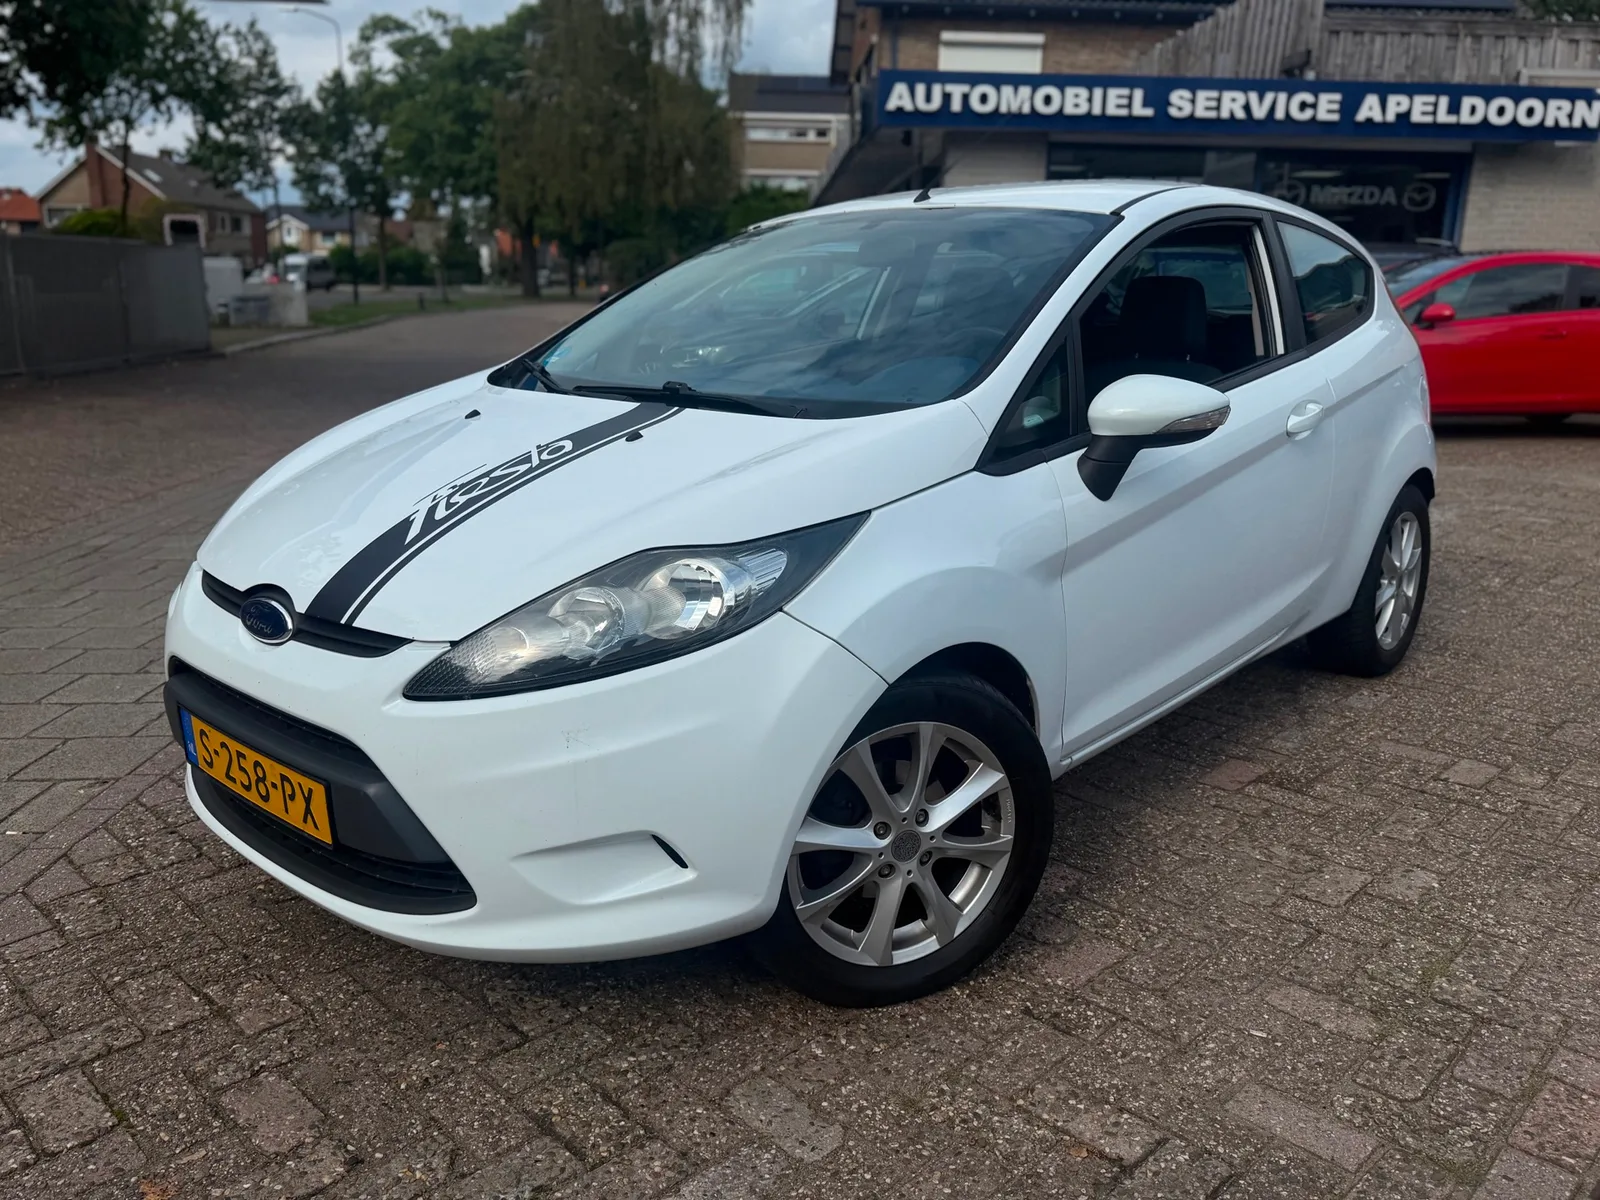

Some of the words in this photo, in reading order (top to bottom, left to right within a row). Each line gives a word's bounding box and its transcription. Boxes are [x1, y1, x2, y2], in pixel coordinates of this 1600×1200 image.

[885, 82, 1154, 117] AUTOMOBIEL
[1167, 89, 1342, 122] SERVICE
[1354, 94, 1600, 129] APELDOORN
[1309, 184, 1398, 206] MAZDA
[199, 728, 319, 831] S-258-PX
